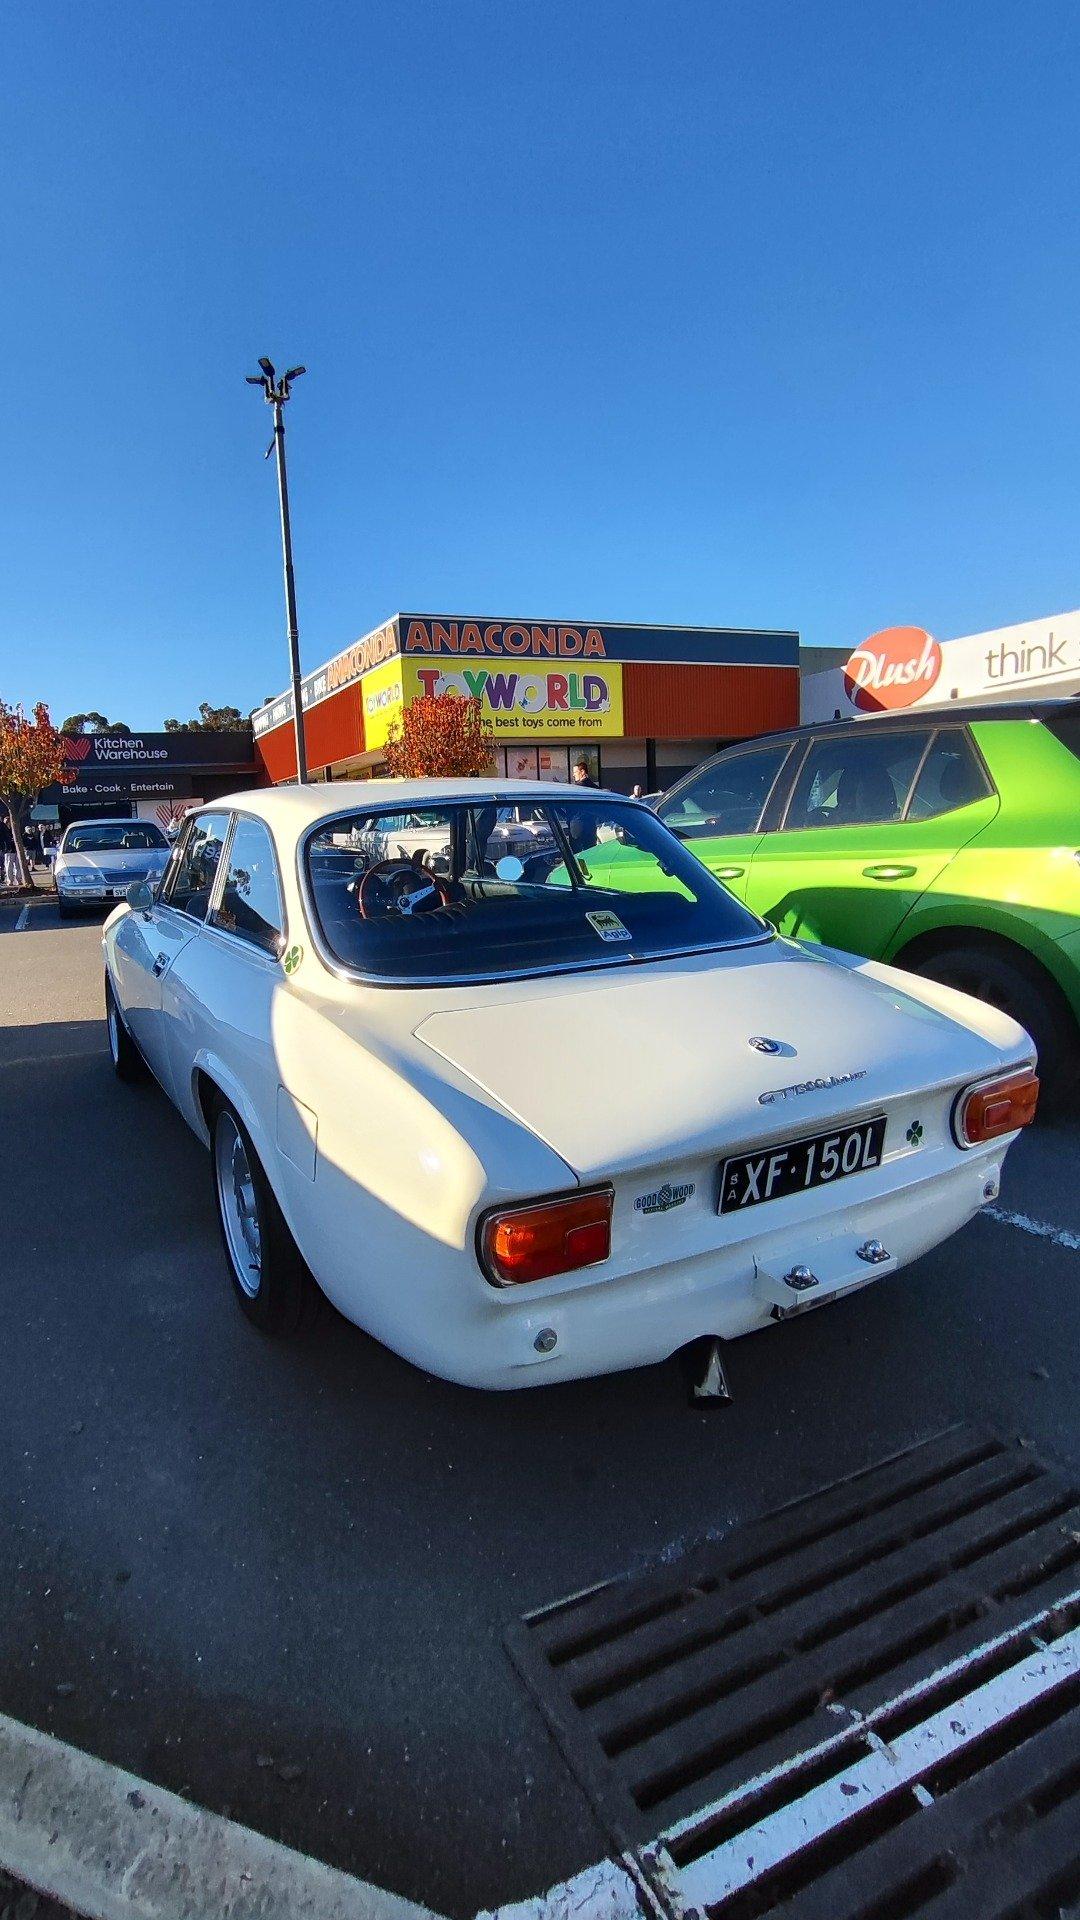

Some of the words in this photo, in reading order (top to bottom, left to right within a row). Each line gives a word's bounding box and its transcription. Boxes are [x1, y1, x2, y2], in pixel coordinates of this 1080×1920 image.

[405, 621, 606, 656] ANACONDA
[984, 632, 1067, 678] think
[850, 633, 936, 704] Plush
[417, 669, 610, 713] TOYWORLD
[495, 716, 520, 727] best
[522, 717, 545, 729] toys
[546, 718, 575, 727] come
[578, 716, 603, 727] from
[94, 738, 144, 749] Kitchen
[95, 749, 168, 760] Warehouse
[62, 785, 88, 794] Bake
[94, 783, 121, 793] Cook
[130, 782, 175, 792] Entertain
